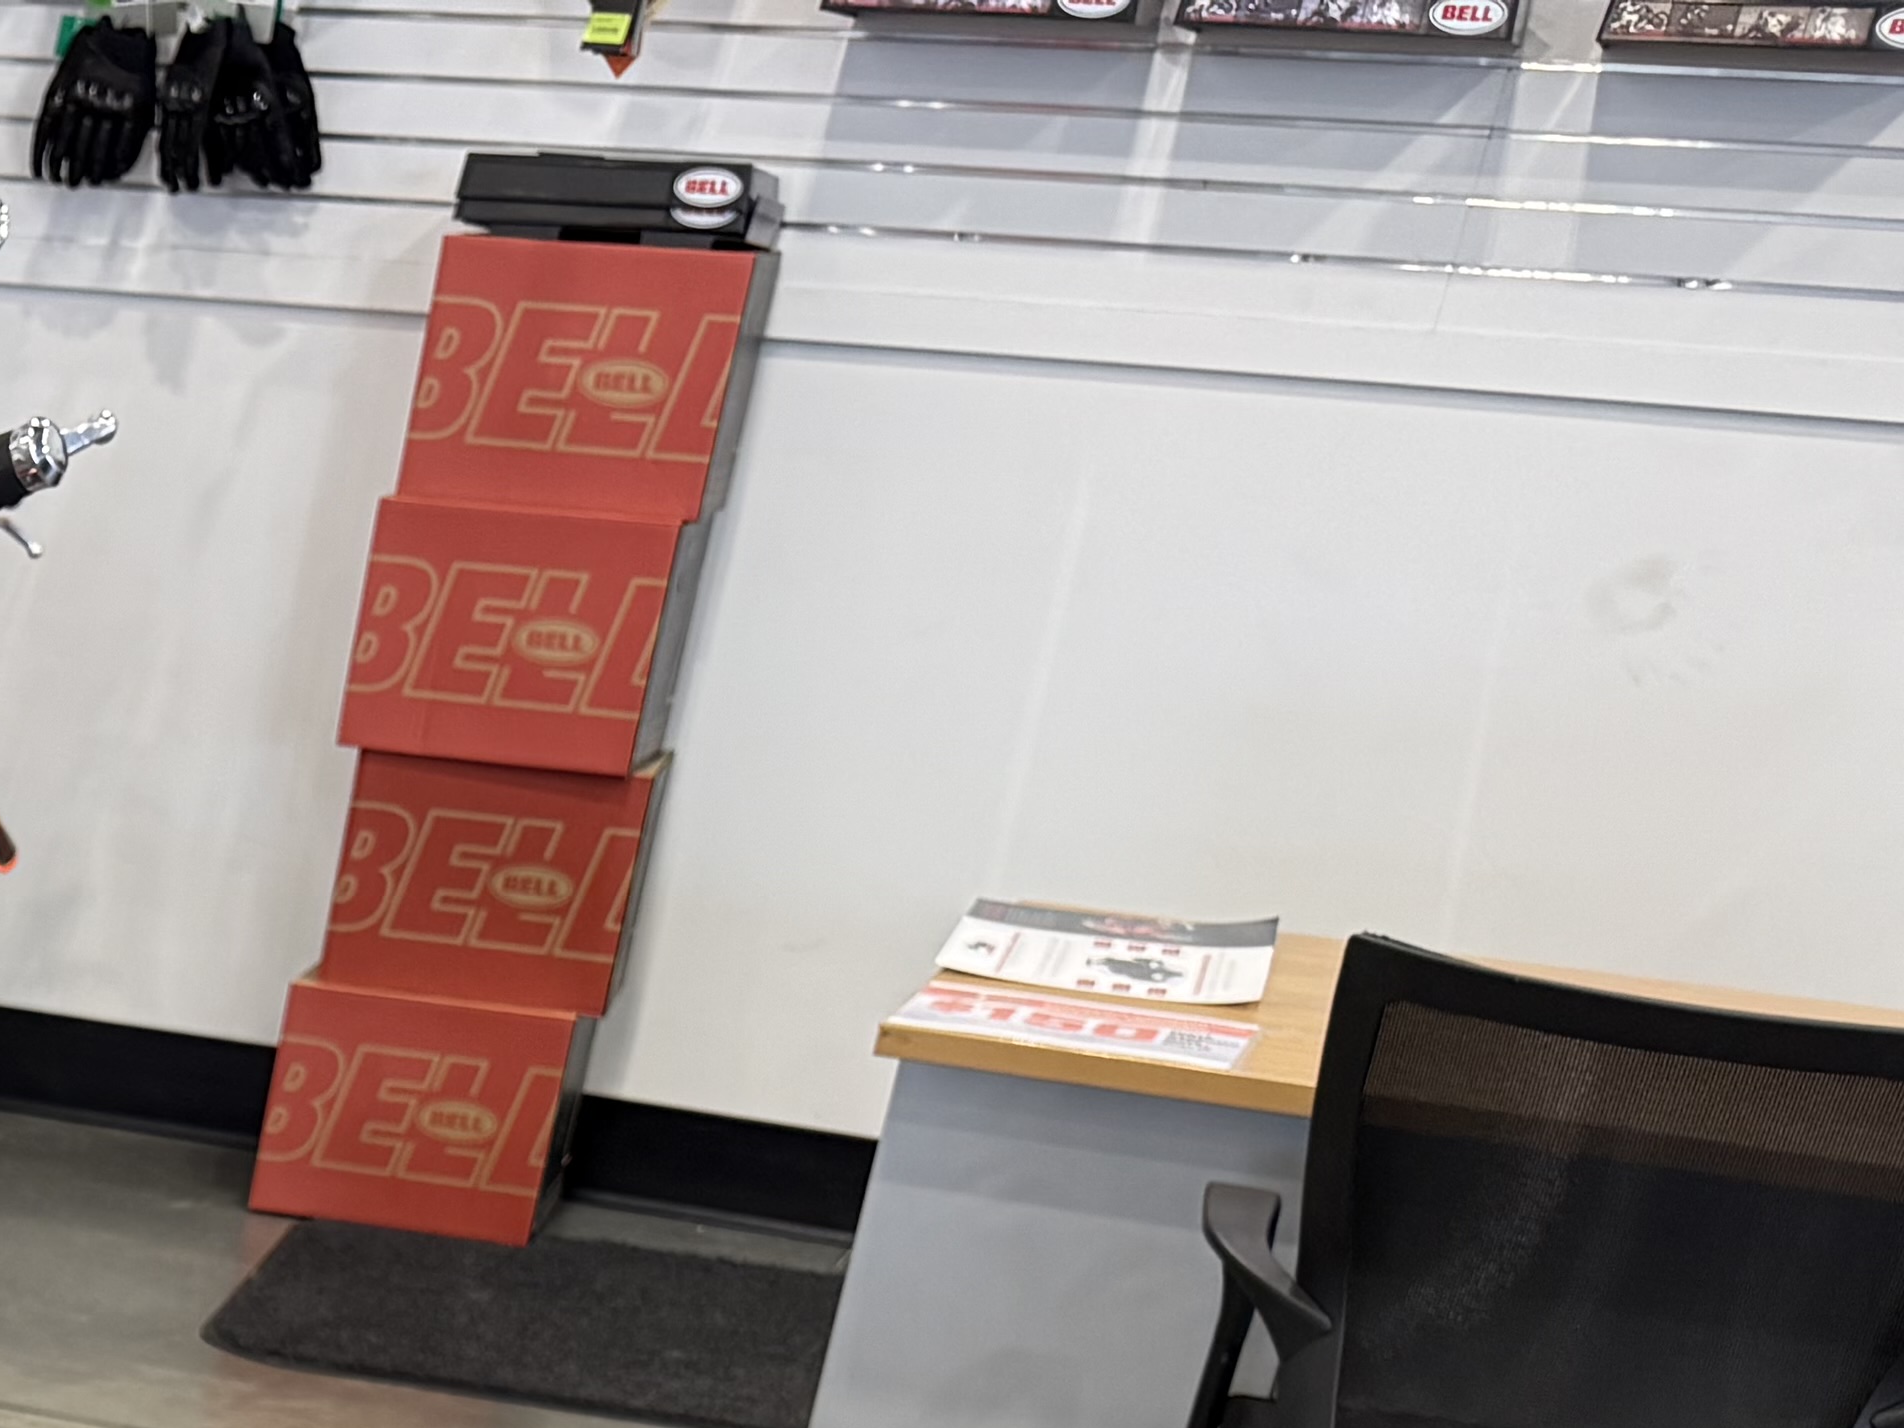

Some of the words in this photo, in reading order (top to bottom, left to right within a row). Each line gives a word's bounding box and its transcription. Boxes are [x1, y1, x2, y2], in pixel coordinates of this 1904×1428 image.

[1442, 4, 1493, 22] BELL
[685, 179, 730, 196] BELL
[407, 295, 741, 463] BELL
[592, 367, 655, 396] BELL
[344, 554, 668, 719] BELL
[523, 626, 587, 654] BELL
[327, 800, 639, 964] BELL
[501, 873, 561, 899] BELL
[258, 1034, 561, 1197] BELL
[430, 1105, 487, 1133] BELL
